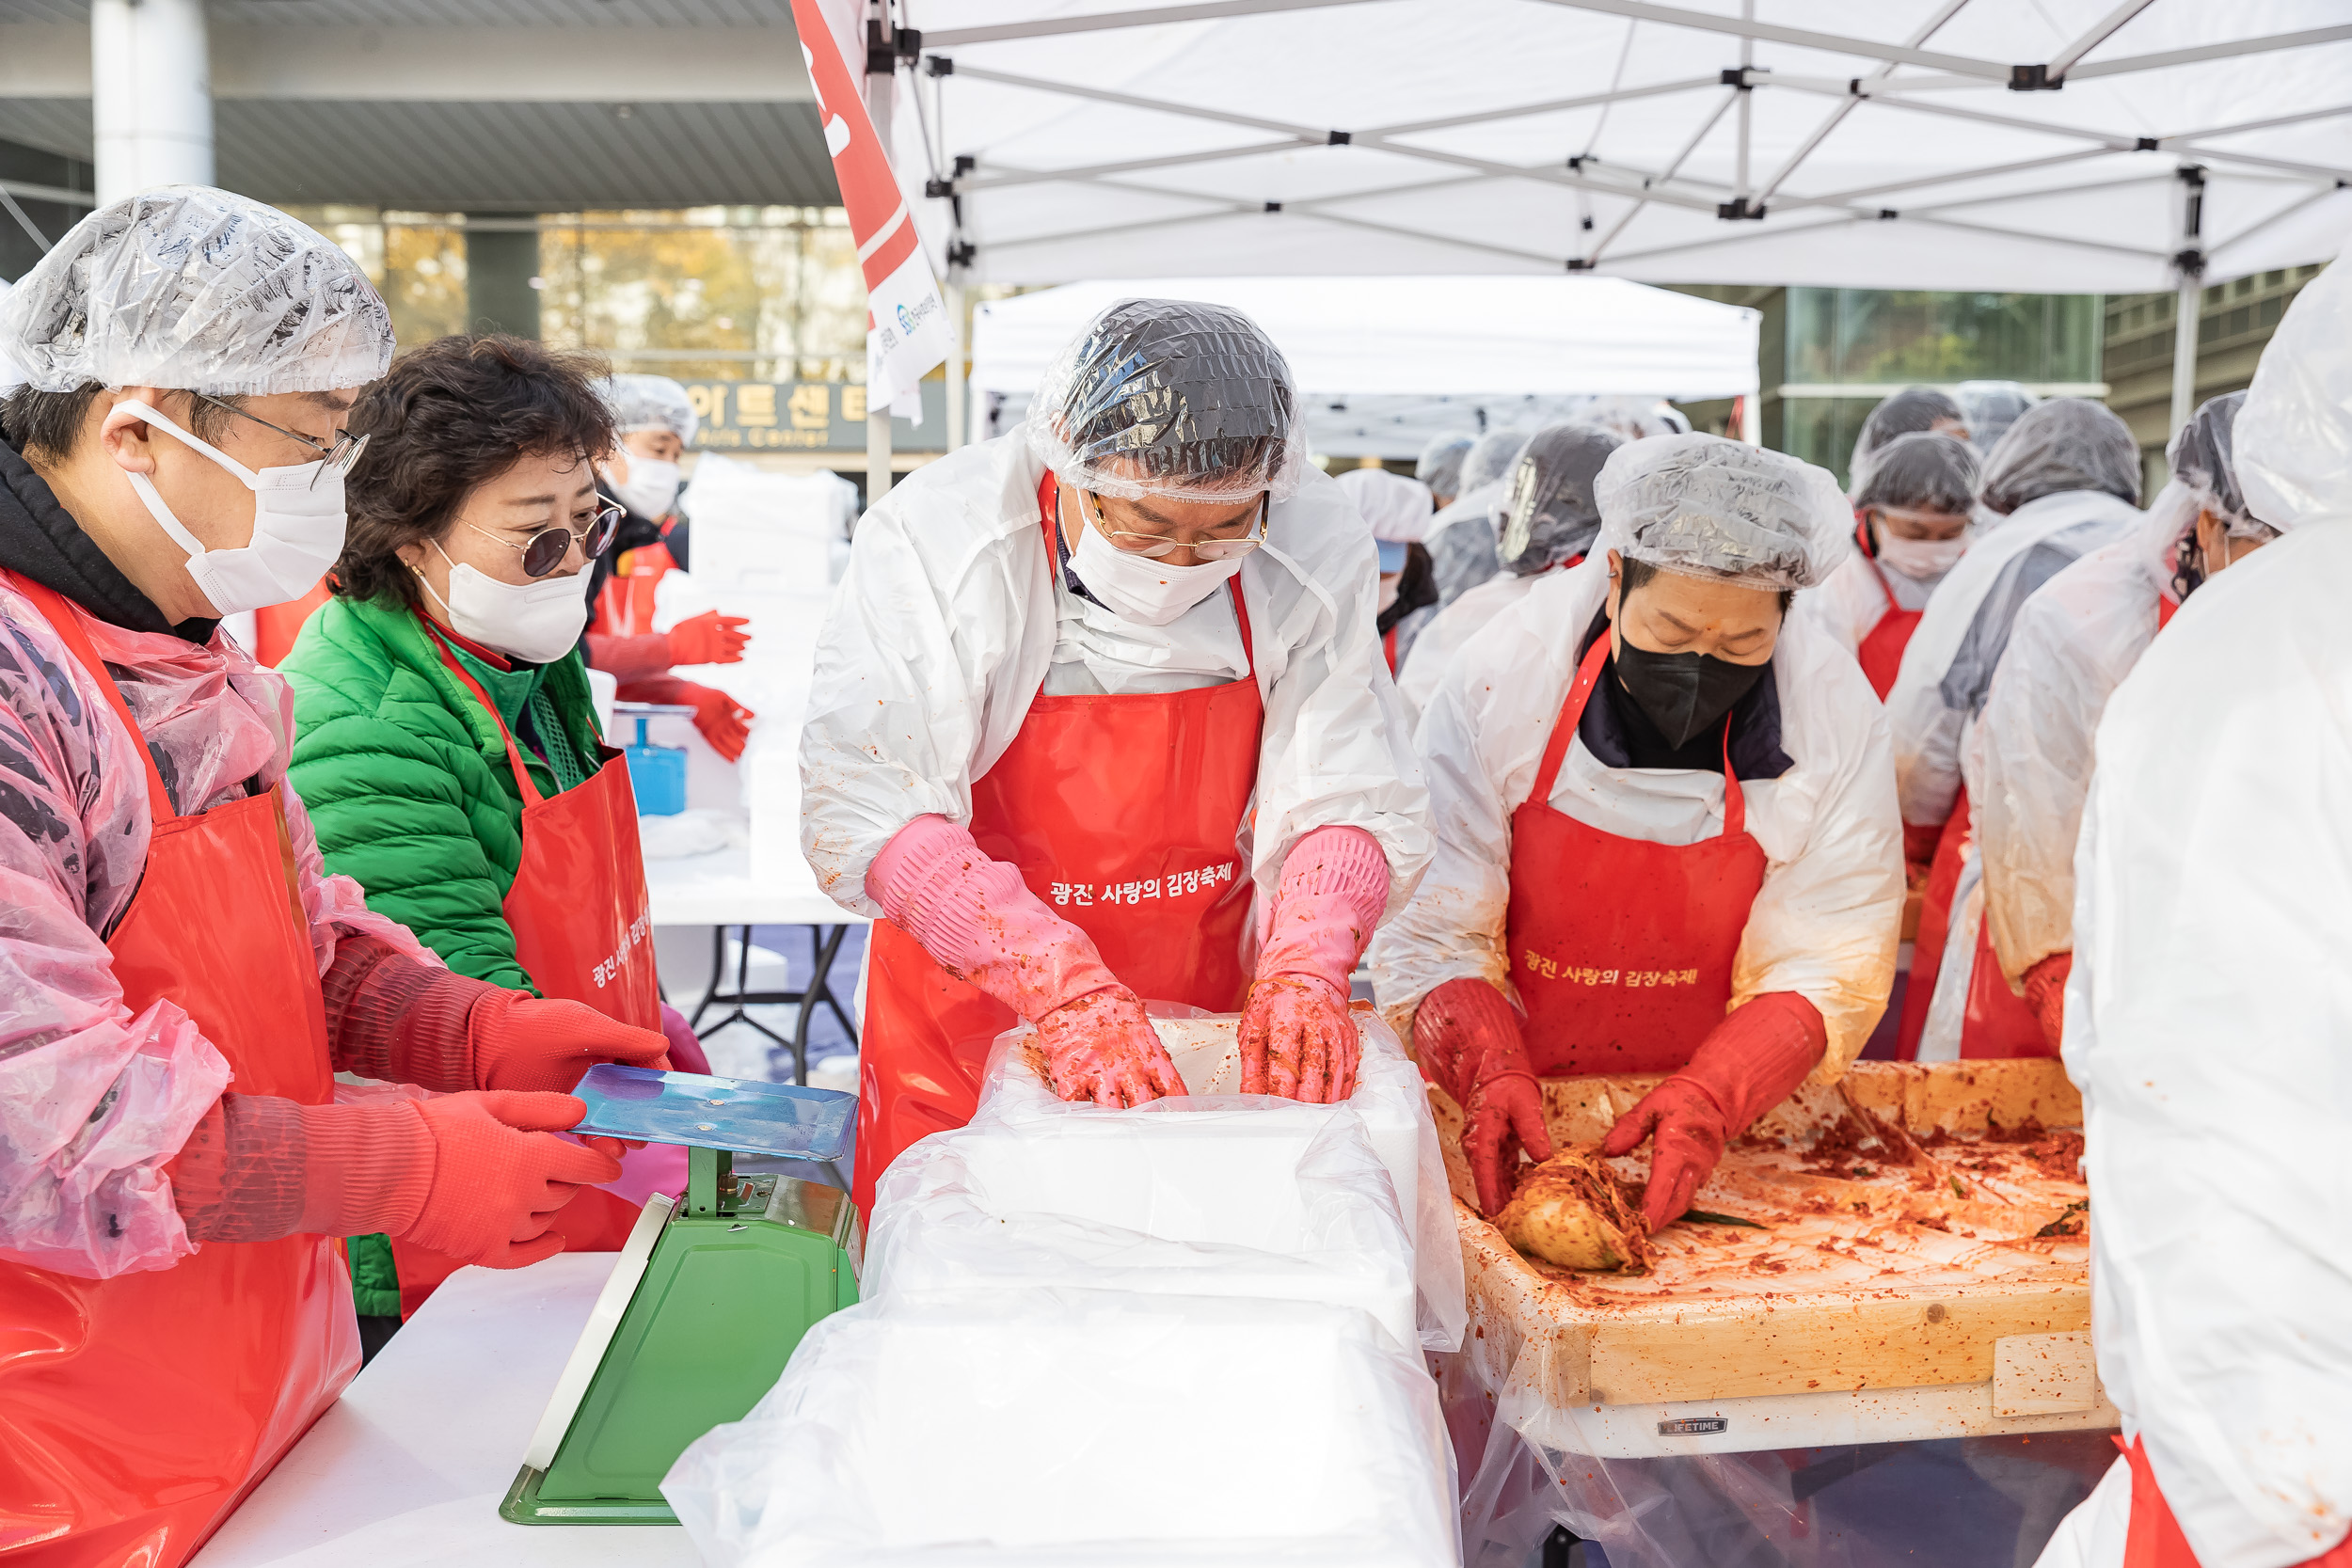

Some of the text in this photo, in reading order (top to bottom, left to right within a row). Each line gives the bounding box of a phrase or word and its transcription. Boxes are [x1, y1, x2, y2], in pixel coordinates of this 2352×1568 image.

[1050, 862, 1234, 906] 광진 사랑의 김장축제
[592, 955, 616, 989] 광진
[1524, 949, 1698, 988] 광진 사랑의 김장축제
